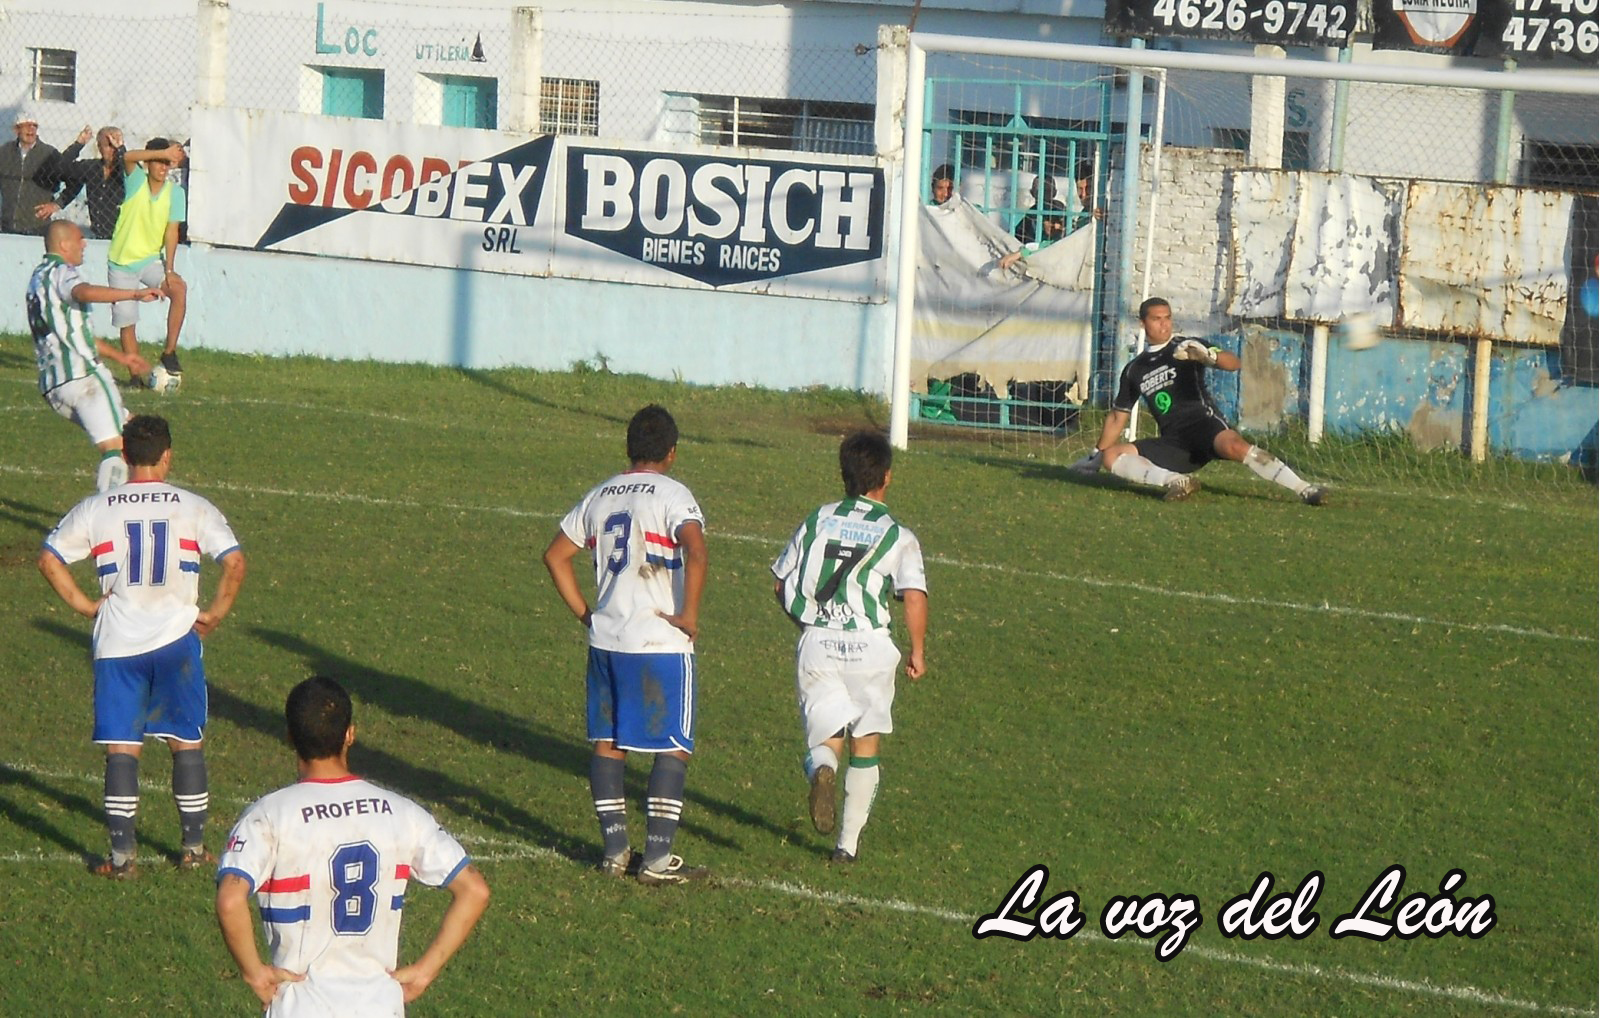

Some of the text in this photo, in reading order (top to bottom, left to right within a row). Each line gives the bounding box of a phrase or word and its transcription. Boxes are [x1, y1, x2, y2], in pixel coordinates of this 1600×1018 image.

[1152, 0, 1348, 39] 4626-9742
[1501, 16, 1599, 54] 4736
[288, 145, 537, 227] SICOBEX
[581, 153, 874, 251] BOSICH
[642, 237, 782, 273] BIENES RAICES
[1139, 367, 1178, 394] ROBERT'S
[107, 492, 181, 506] PROFETA
[600, 483, 656, 498] PROFETA
[124, 519, 169, 586] 11
[603, 509, 633, 577] 3
[814, 544, 870, 603] 7
[301, 798, 393, 824] PROFETA
[328, 839, 381, 937] 8
